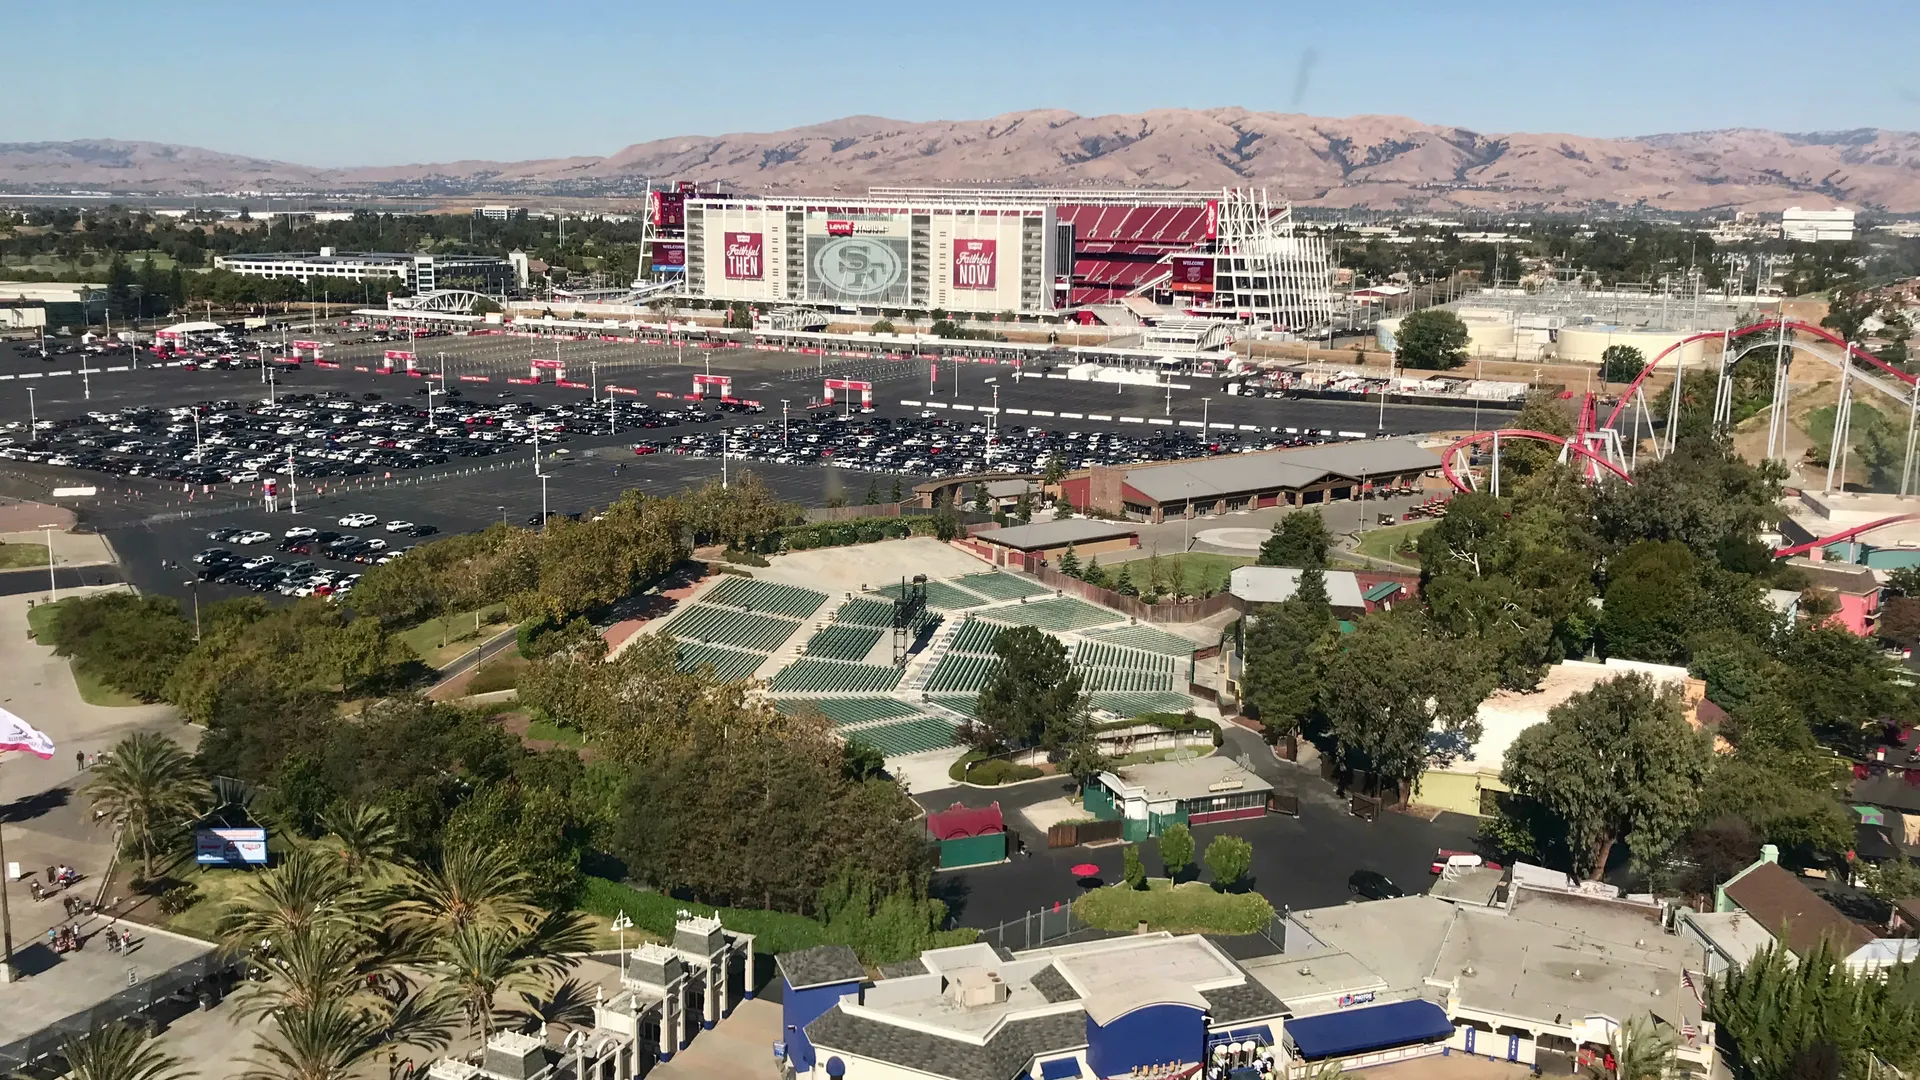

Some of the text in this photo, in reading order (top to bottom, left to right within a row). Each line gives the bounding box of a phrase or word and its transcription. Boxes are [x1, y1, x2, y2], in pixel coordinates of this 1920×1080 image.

[853, 224, 884, 233] STADIUM
[726, 244, 760, 258] Faithful
[956, 252, 993, 265] Faithful
[728, 256, 757, 275] THEN
[959, 264, 990, 285] NOW
[1354, 993, 1372, 1003] PHOTOS
